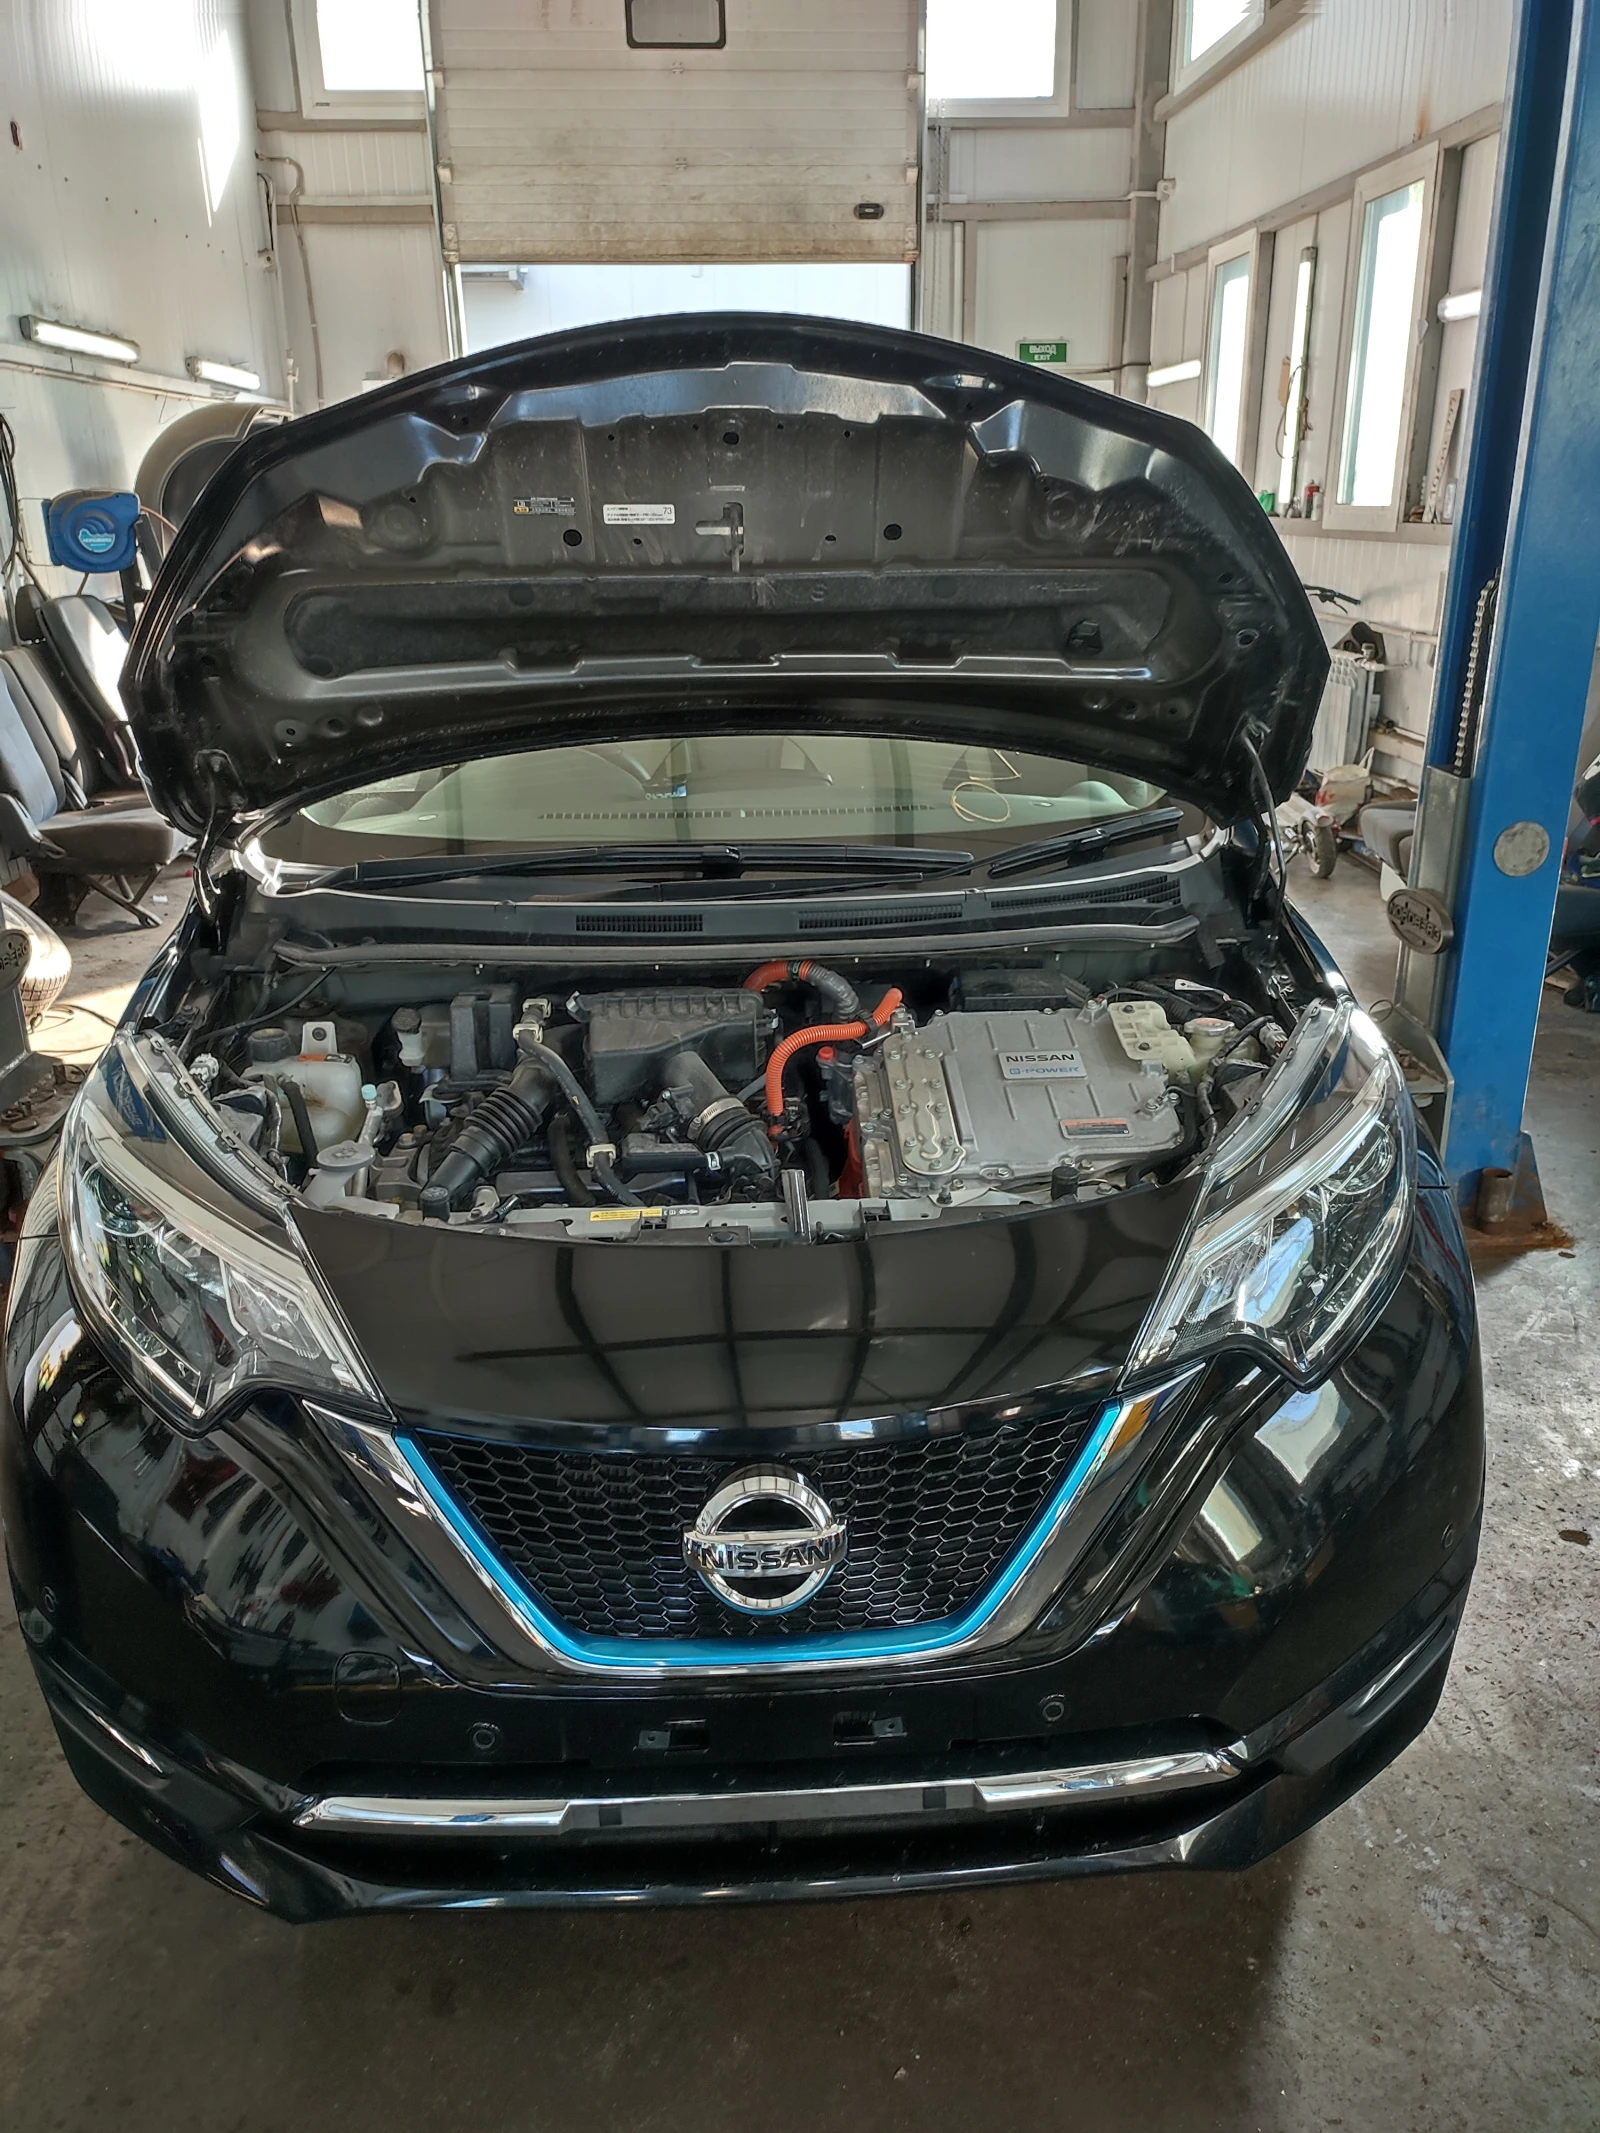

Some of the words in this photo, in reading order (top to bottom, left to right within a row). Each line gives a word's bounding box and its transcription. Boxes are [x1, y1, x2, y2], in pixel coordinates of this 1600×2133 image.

[1029, 344, 1057, 355] ВЫХОД
[662, 506, 673, 515] 73
[1005, 1053, 1075, 1063] NISSAN
[701, 1545, 831, 1570] NISSAN
